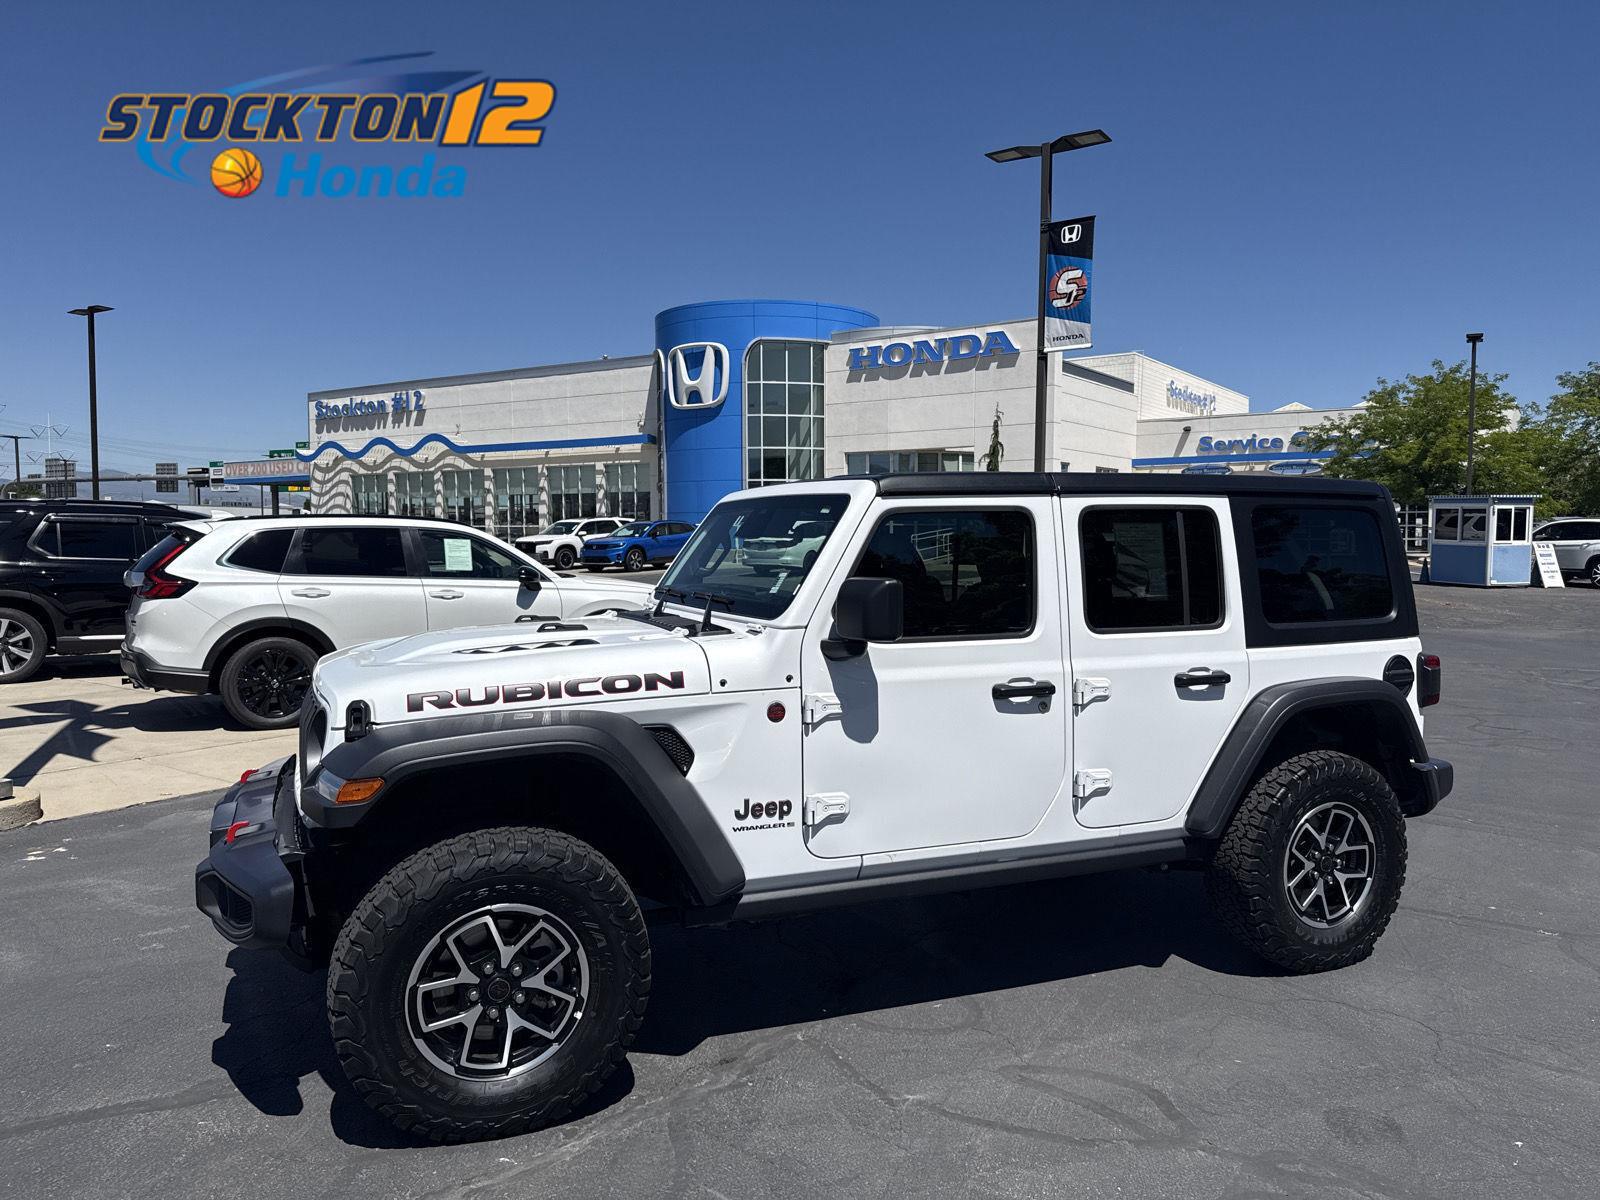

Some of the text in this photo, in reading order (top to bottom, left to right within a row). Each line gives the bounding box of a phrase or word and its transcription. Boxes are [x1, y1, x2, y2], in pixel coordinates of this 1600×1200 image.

[1052, 333, 1085, 342] HONDA
[849, 330, 1020, 371] HONDA
[314, 390, 424, 420] Stockton #12
[1199, 433, 1284, 452] Service
[225, 462, 249, 477] OVER
[251, 462, 268, 475] 200
[270, 460, 294, 474] USED
[406, 670, 686, 713] RUBICON
[734, 798, 793, 821] Jeep
[731, 822, 786, 833] WRANGLER
